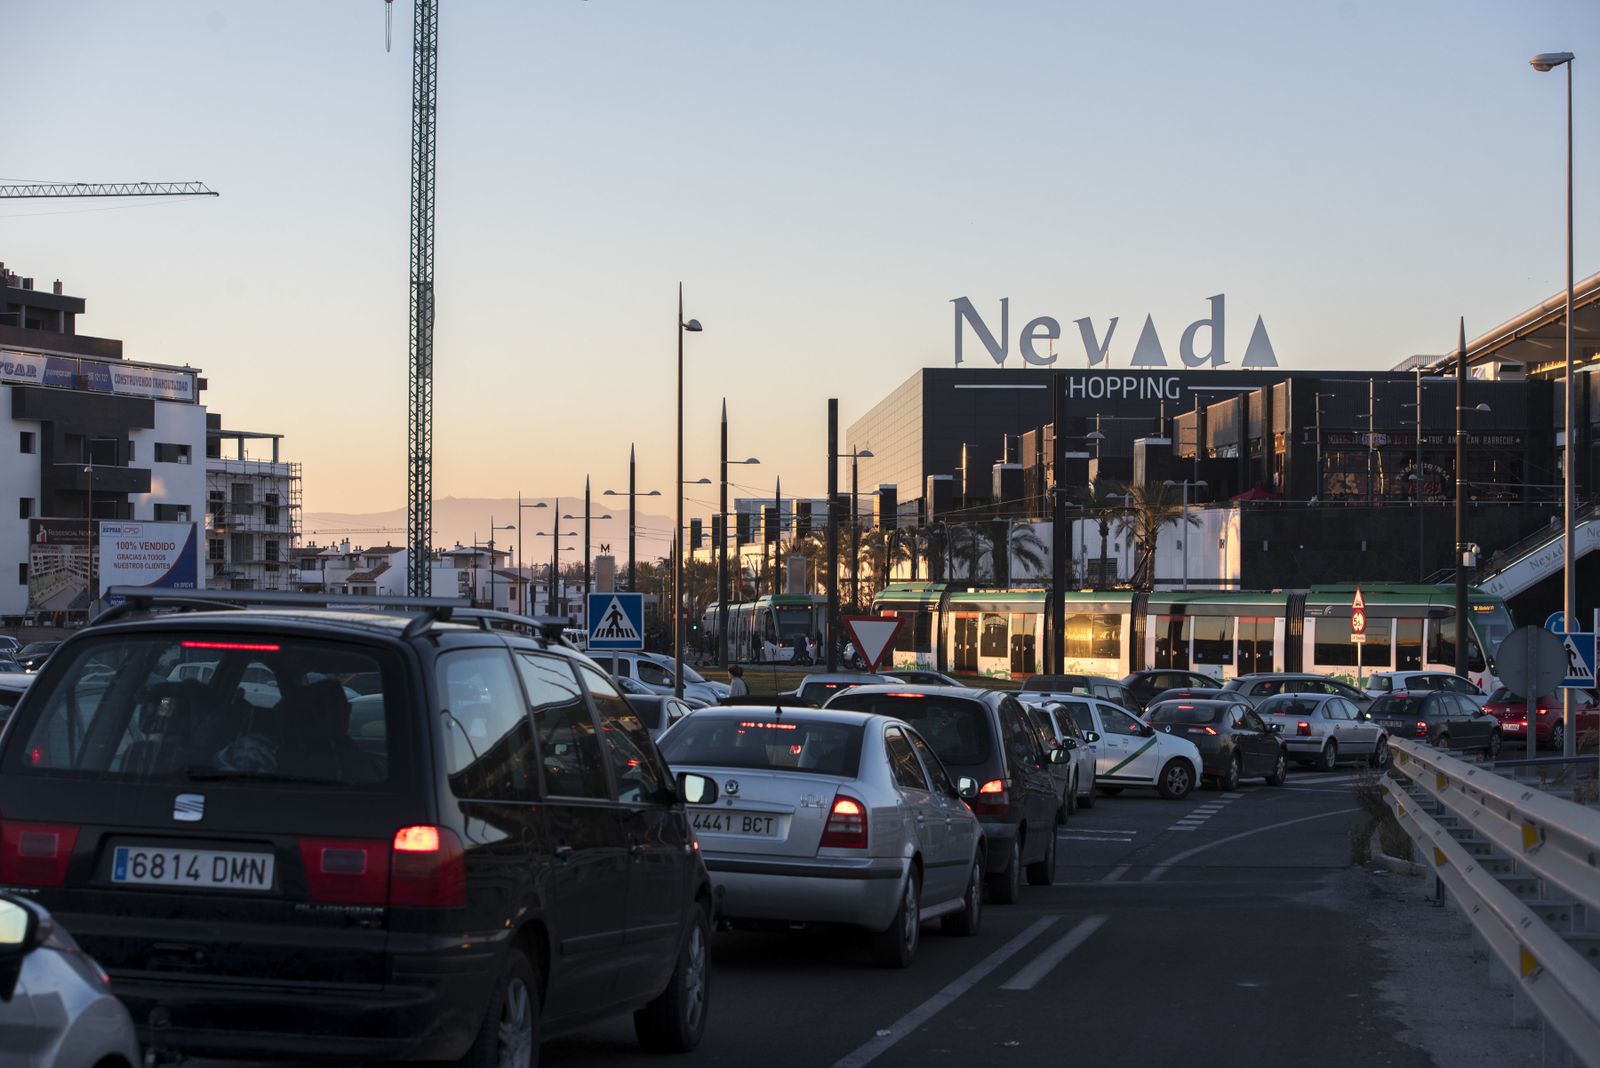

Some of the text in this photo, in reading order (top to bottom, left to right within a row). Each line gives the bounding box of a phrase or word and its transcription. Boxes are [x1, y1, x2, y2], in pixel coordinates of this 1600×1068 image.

[115, 373, 188, 391] CONSTRUYENDO TRANQUILIDAD
[1065, 376, 1180, 400] HOPPING
[1428, 435, 1443, 444] TRUE
[116, 541, 176, 551] 100% VENDIDO
[601, 544, 610, 553] M
[692, 814, 774, 833] 4441 BCT
[132, 852, 266, 885] 6814 DMN
